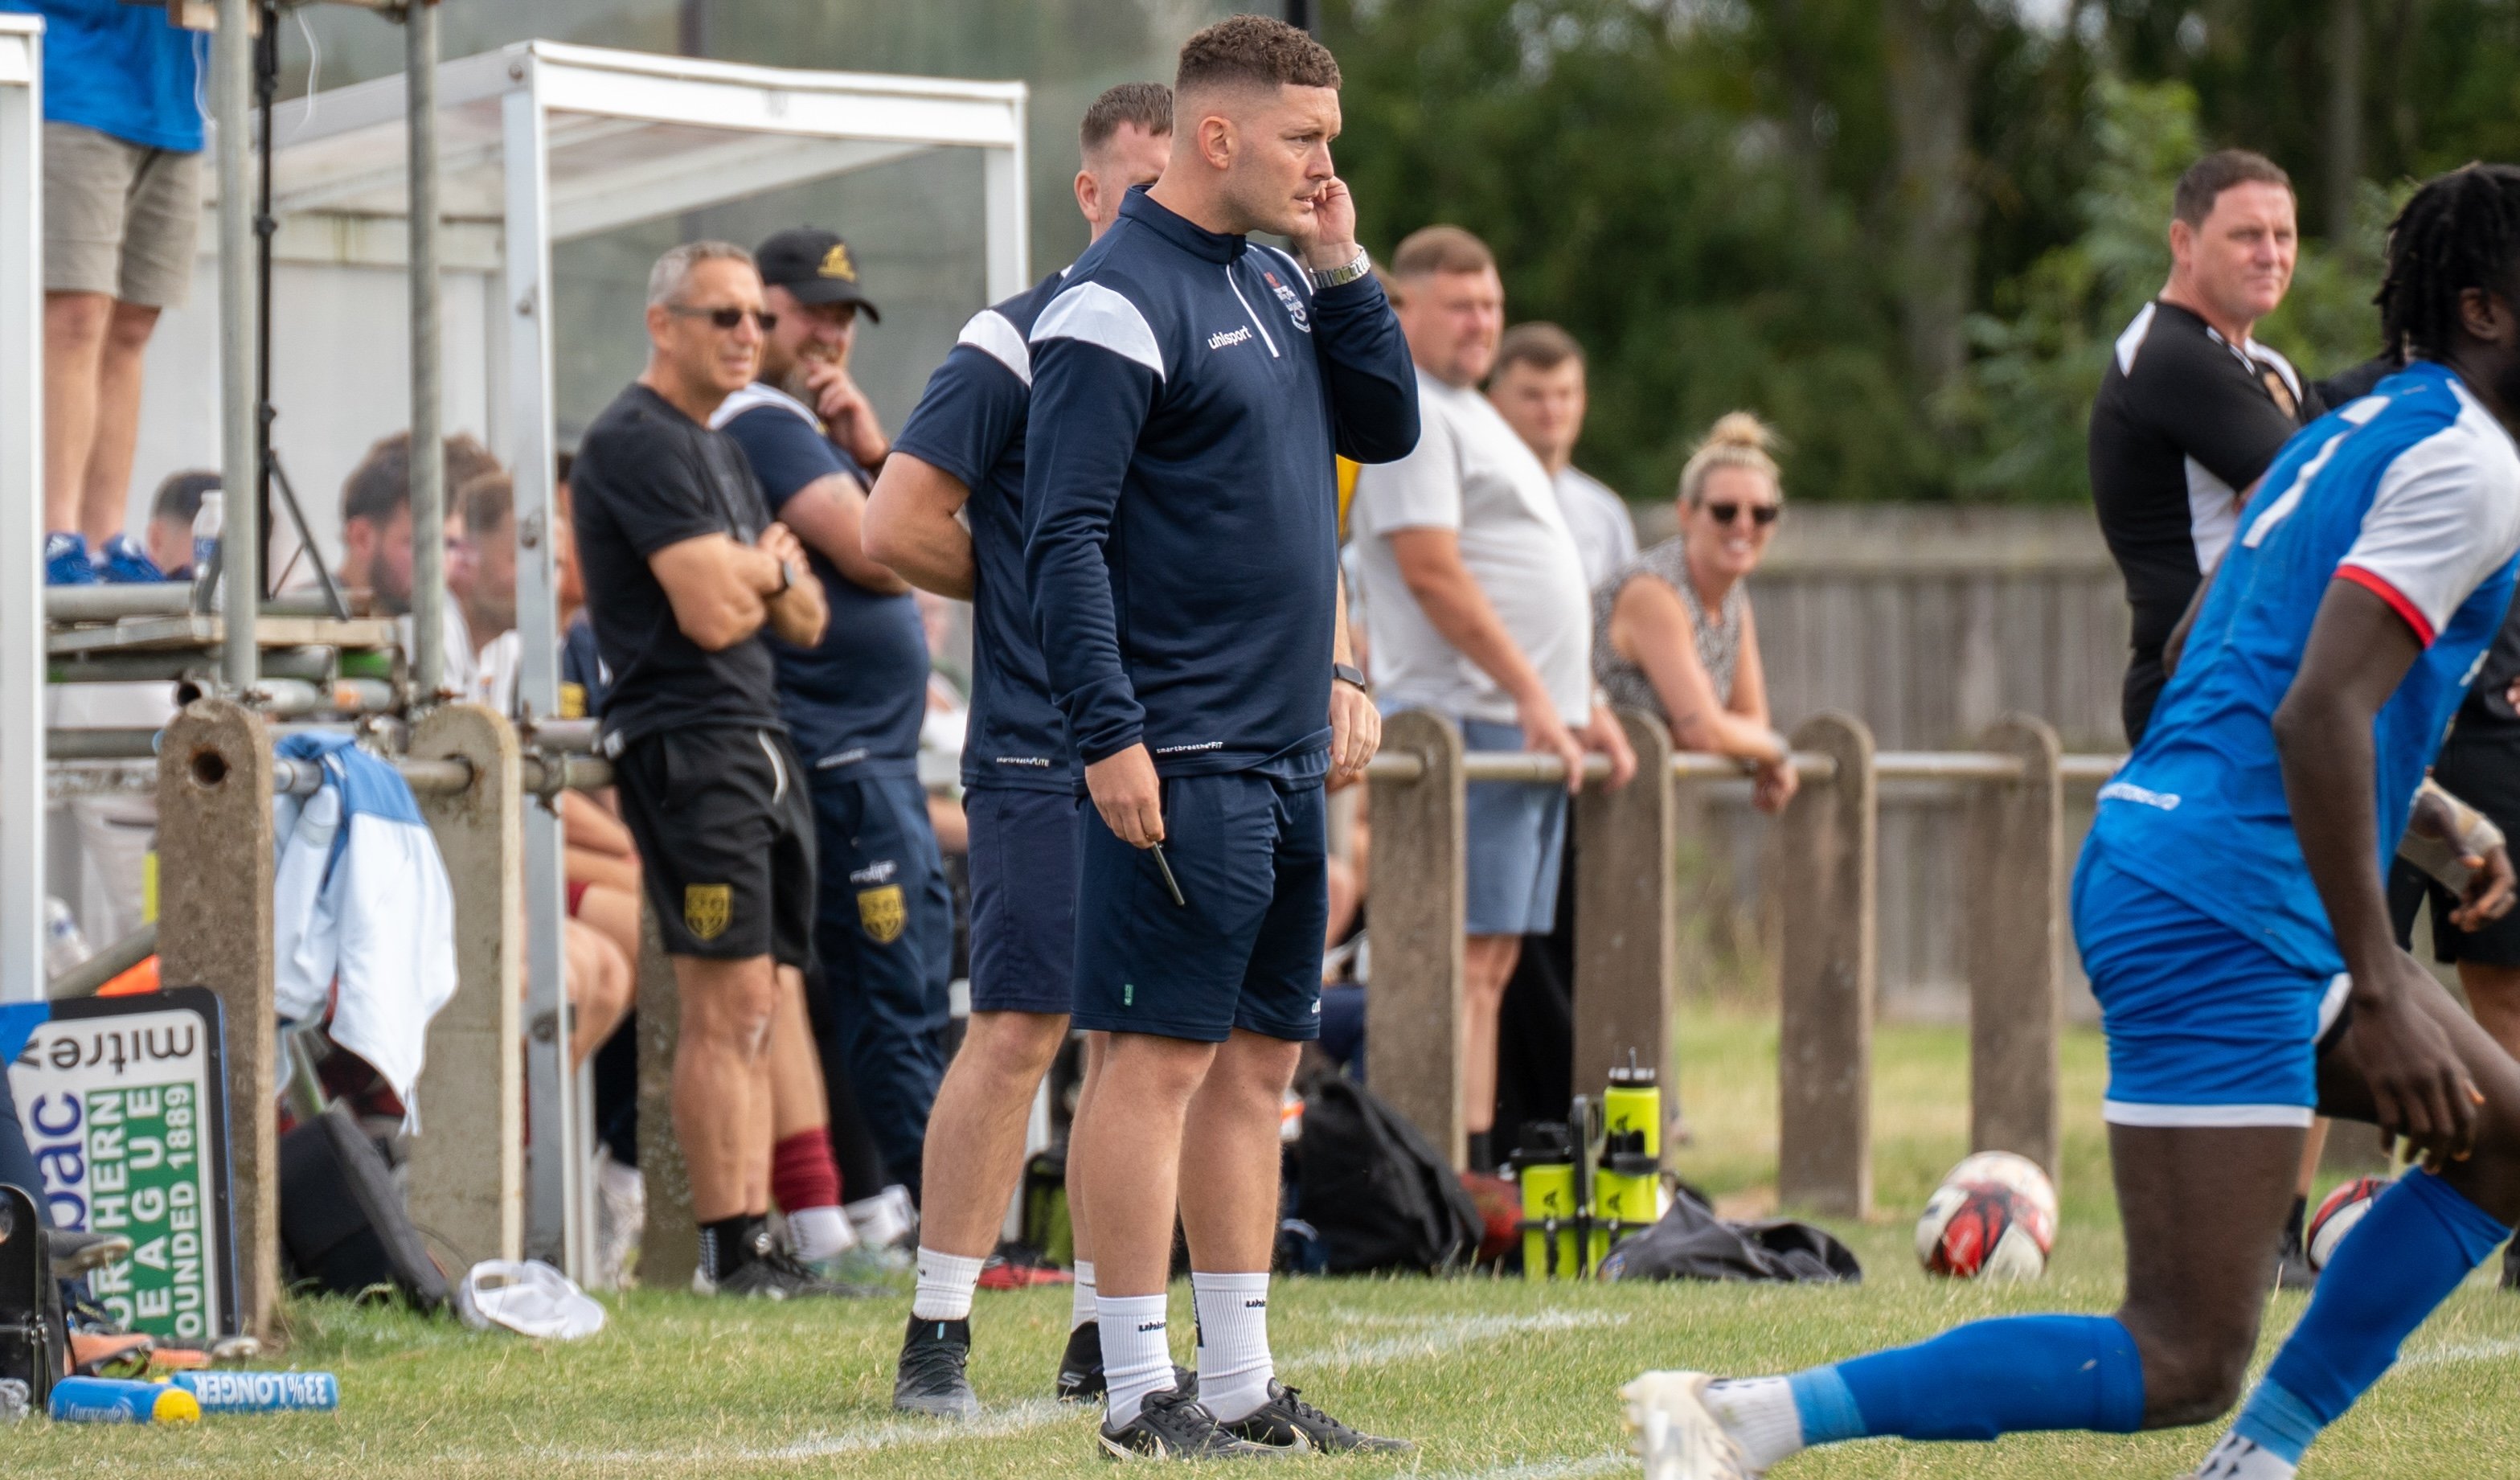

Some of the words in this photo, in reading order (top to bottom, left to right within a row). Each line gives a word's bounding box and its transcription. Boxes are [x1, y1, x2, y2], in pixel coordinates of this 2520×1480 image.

[1207, 325, 1252, 349] uhlsport
[49, 1025, 195, 1075] mitre
[164, 1083, 195, 1170] 1889
[89, 1091, 134, 1330] ORHERN
[127, 1088, 170, 1318] EAGUE
[169, 1180, 202, 1338] OUNDED
[191, 1373, 285, 1405] LONGER
[287, 1373, 328, 1404] 33%
